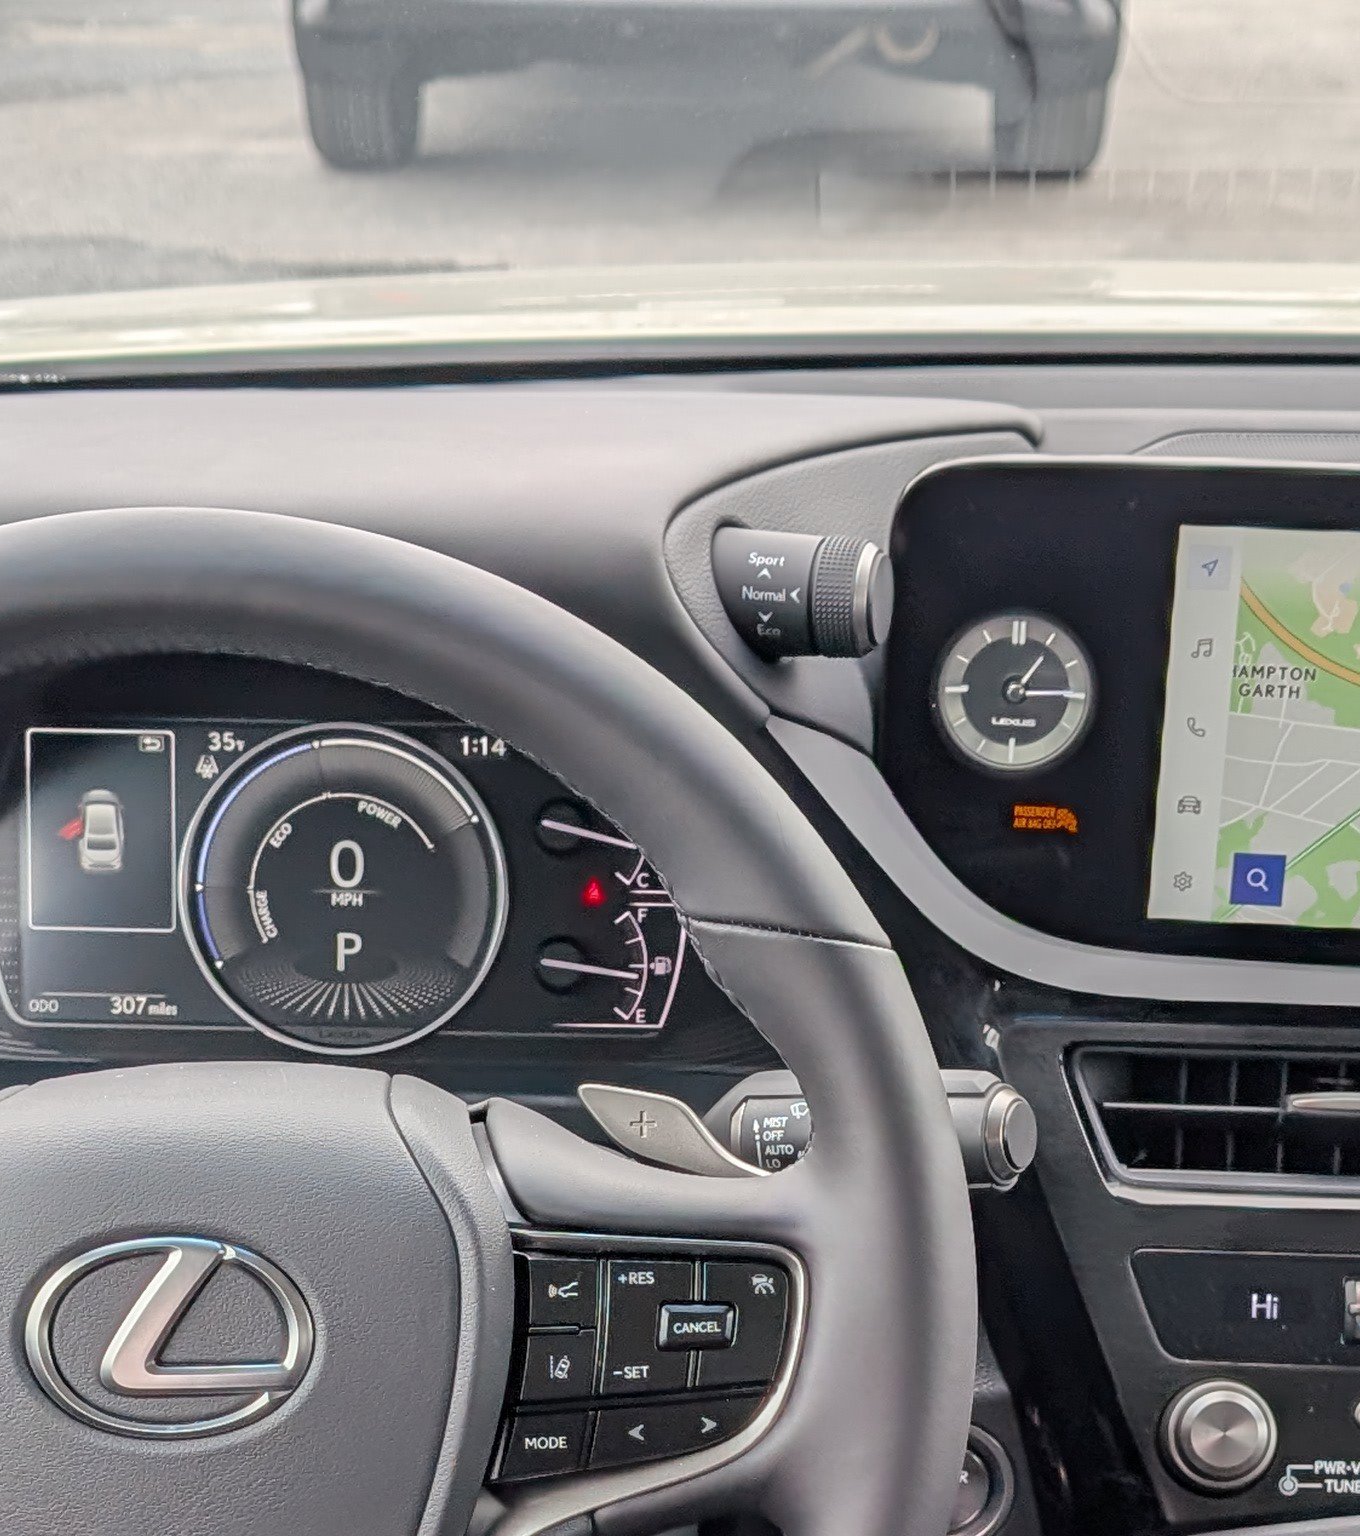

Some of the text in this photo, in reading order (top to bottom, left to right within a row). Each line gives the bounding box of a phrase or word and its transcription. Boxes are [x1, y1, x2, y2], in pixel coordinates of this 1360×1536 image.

[748, 552, 786, 567] Sport
[742, 585, 786, 602] Normal
[756, 623, 782, 637] Eco
[1238, 683, 1301, 699] GARTH
[991, 716, 1037, 728] LEXUS
[460, 735, 507, 757] 1:14
[357, 800, 402, 829] POWER
[269, 823, 292, 848] ECO
[330, 840, 365, 888] 0
[636, 872, 650, 888] C
[330, 892, 364, 906] MPH
[255, 890, 278, 938] CHARGE
[637, 908, 649, 924] F
[336, 932, 362, 972] P
[28, 999, 59, 1013] ODO
[110, 996, 178, 1016] 307 miles
[635, 1008, 647, 1024] E
[763, 1116, 789, 1129] MIST
[762, 1130, 785, 1142] OFF
[765, 1144, 795, 1156] AUTO
[766, 1158, 781, 1169] LO
[1251, 1293, 1279, 1320] Hi
[673, 1321, 721, 1334] CANCEL
[524, 1436, 568, 1450] MODE
